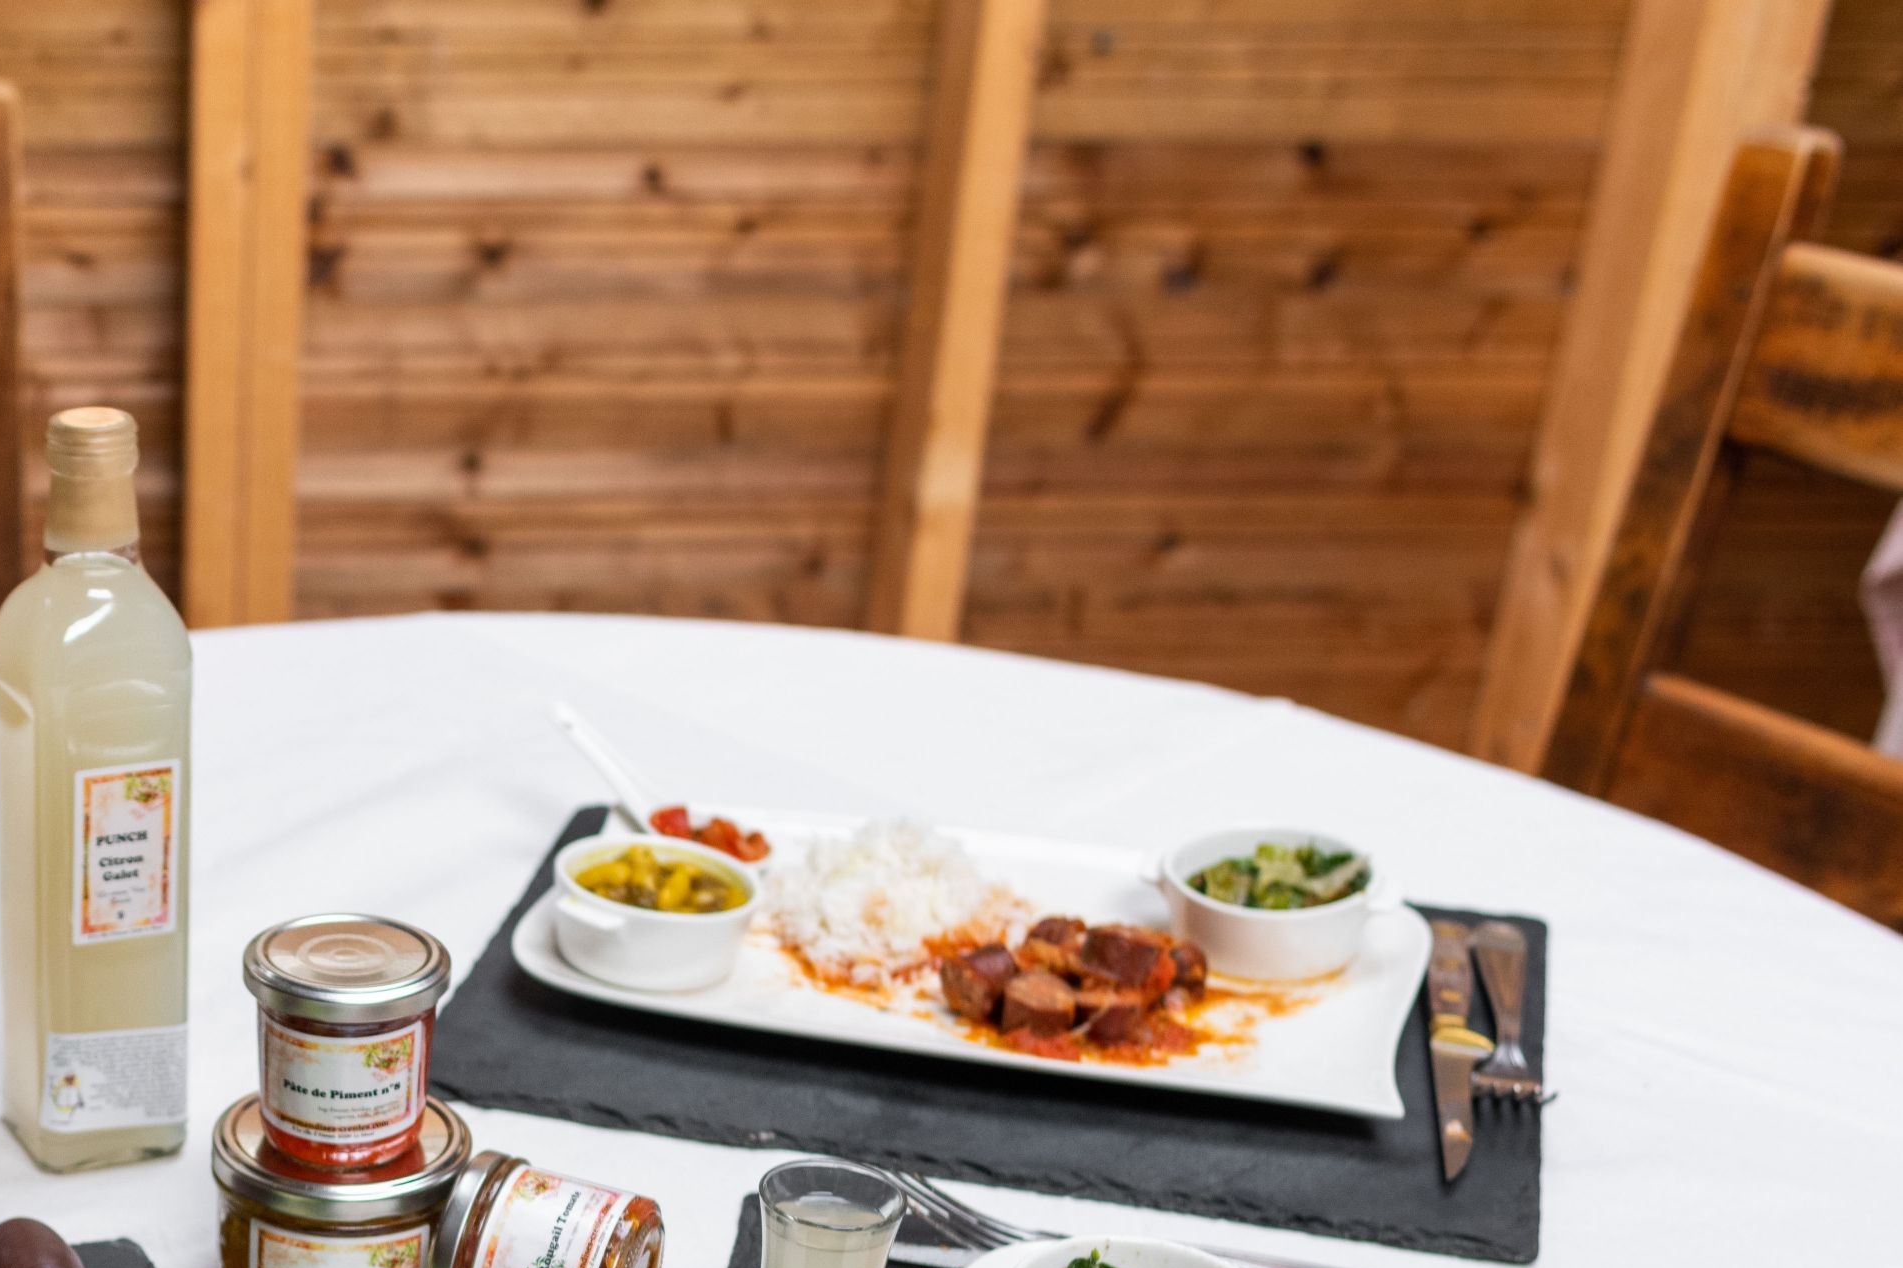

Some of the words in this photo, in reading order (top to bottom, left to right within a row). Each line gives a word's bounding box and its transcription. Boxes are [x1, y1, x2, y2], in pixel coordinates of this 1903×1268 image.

[96, 829, 148, 847] PUNCH
[98, 854, 144, 868] Citron
[102, 868, 139, 882] Galet
[283, 1078, 309, 1095] Pâte
[311, 1088, 327, 1098] de
[330, 1089, 378, 1100] Piment
